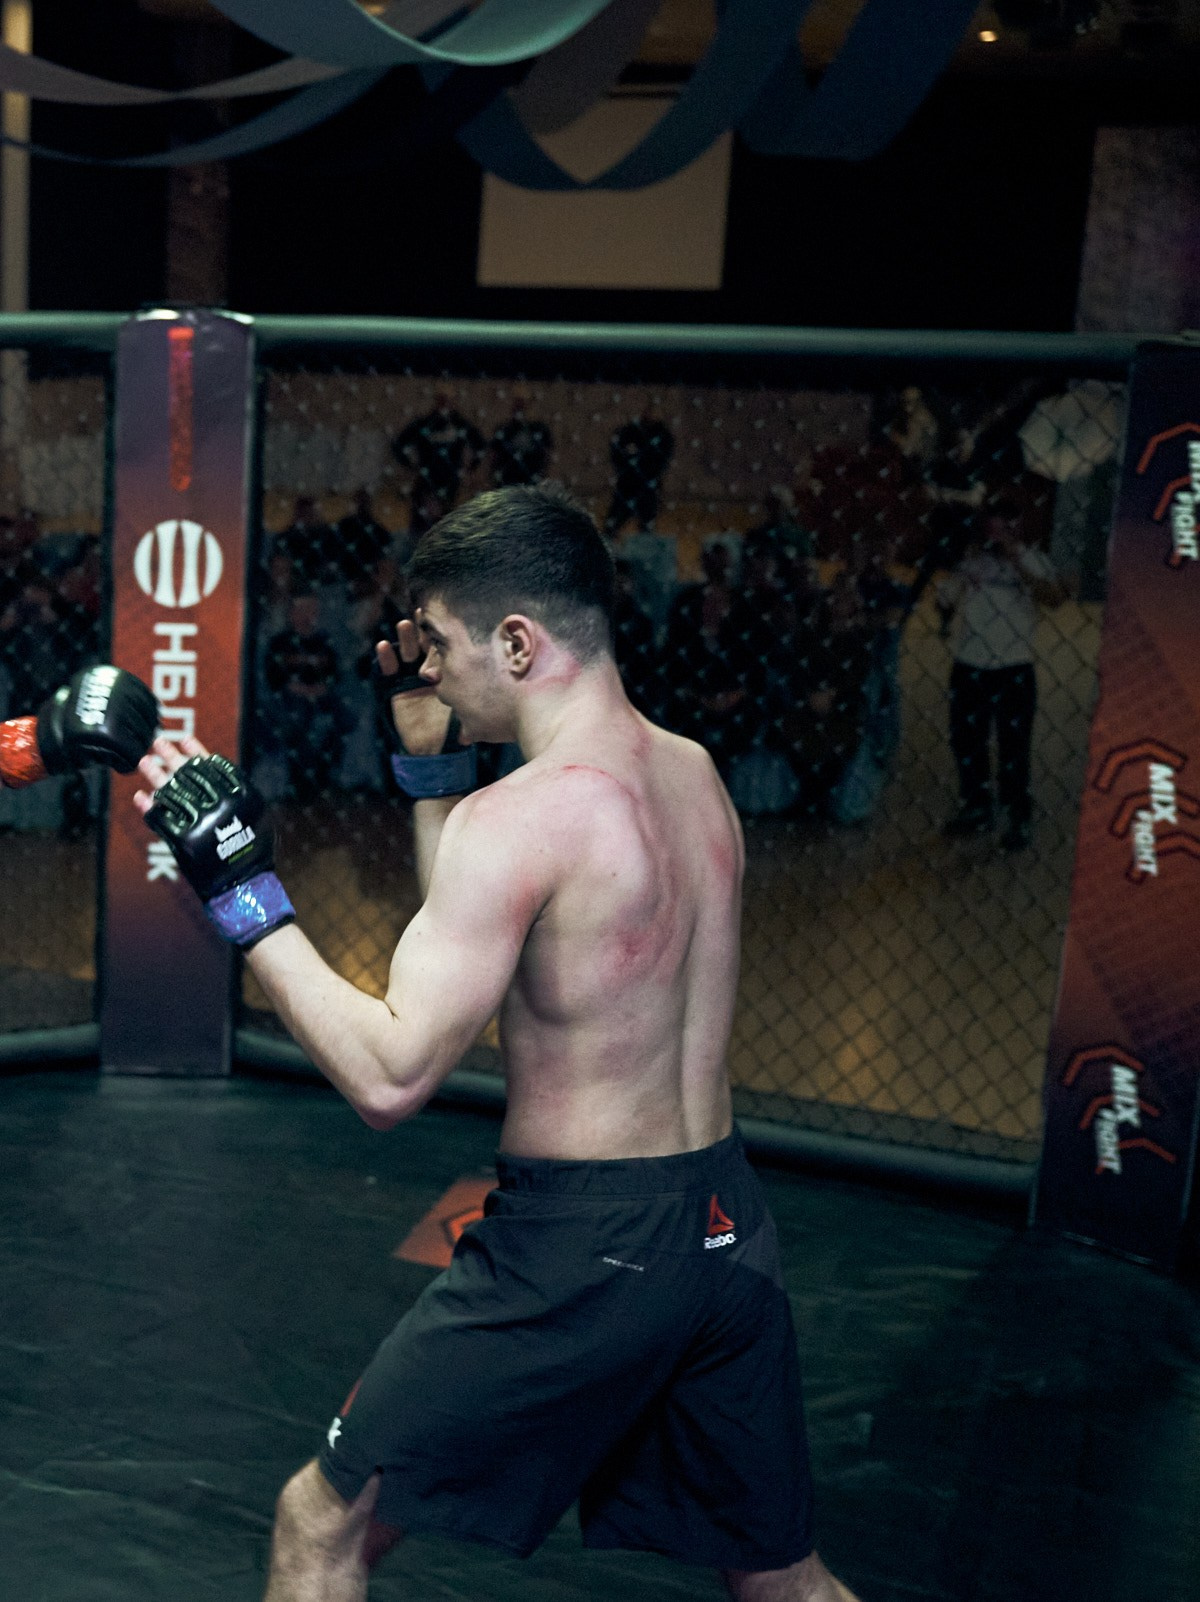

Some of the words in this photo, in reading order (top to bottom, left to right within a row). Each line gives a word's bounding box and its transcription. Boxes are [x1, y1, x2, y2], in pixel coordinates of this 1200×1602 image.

[1148, 762, 1177, 824] MIX
[1112, 1064, 1140, 1127] MIX
[704, 1232, 737, 1250] Reebo
